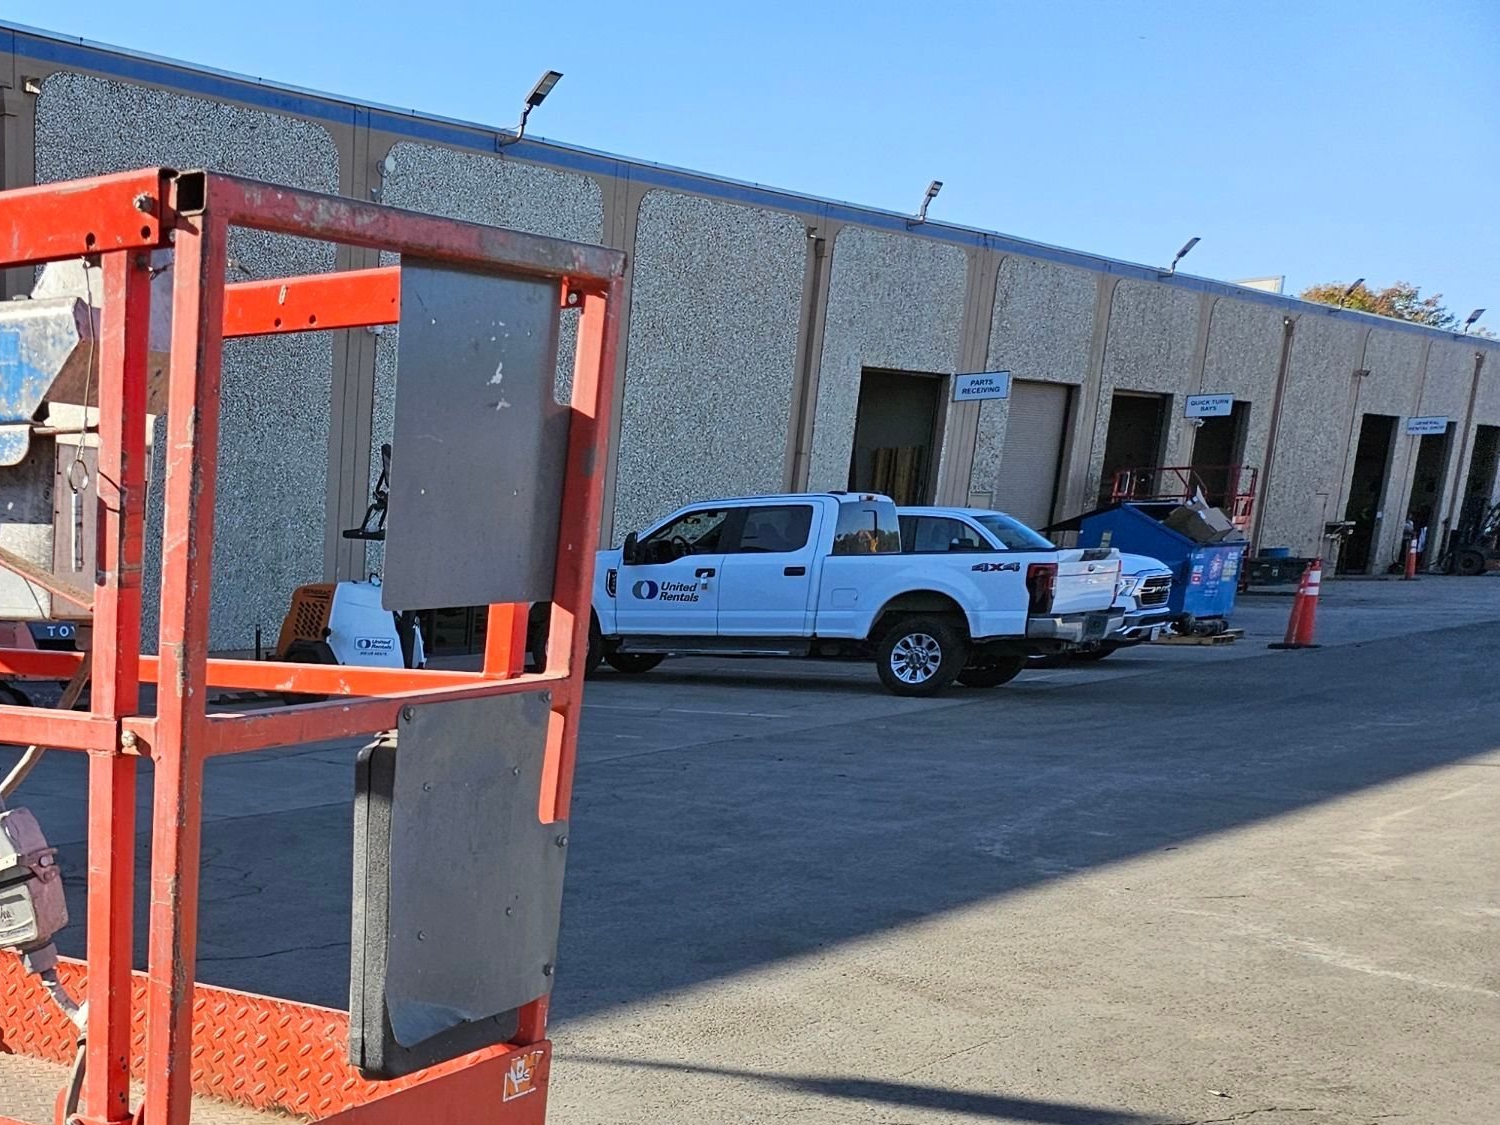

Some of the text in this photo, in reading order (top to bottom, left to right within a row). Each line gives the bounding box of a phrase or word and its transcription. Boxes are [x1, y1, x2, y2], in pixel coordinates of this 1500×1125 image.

[962, 387, 1000, 395] RECEIVING
[660, 581, 698, 593] United
[659, 591, 700, 603] Rentals
